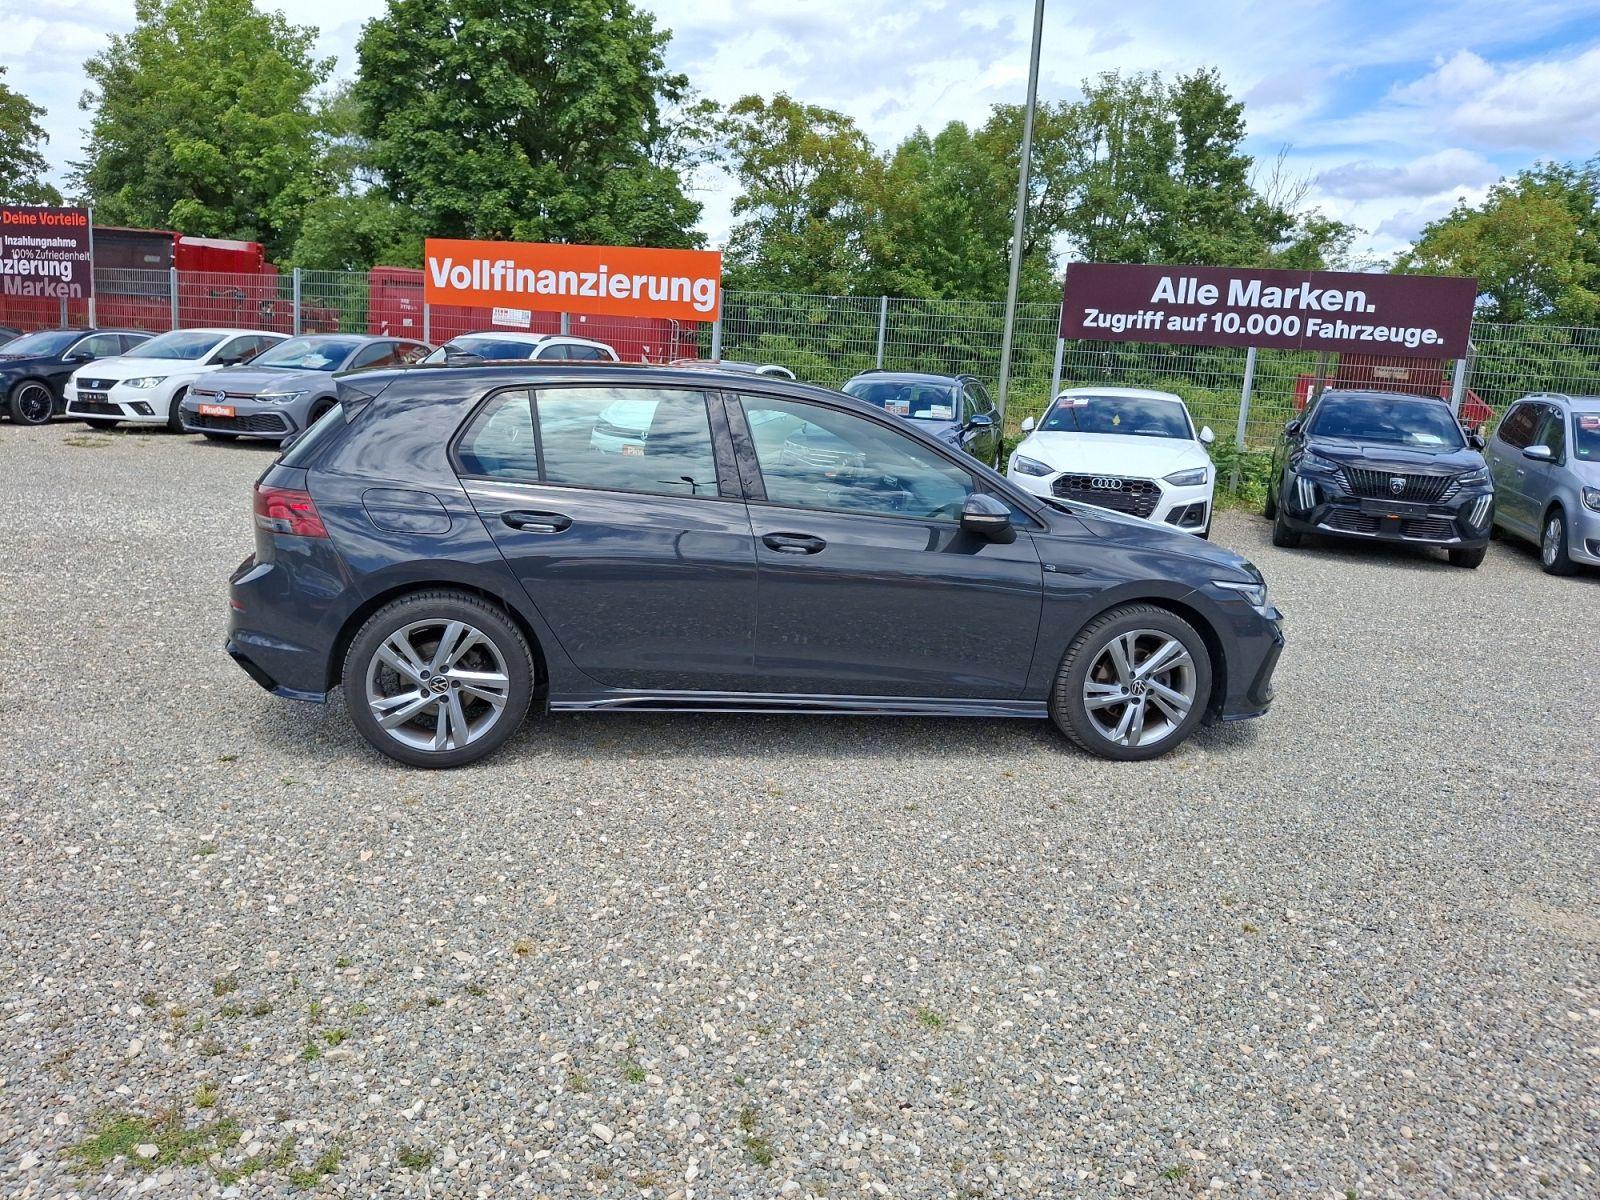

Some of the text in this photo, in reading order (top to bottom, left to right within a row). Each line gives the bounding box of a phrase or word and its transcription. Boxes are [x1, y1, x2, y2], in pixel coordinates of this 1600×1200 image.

[3, 211, 87, 226] Deine Vorteile
[4, 235, 77, 249] Inzahlungnahme
[11, 249, 91, 262] 100% Zufriedenheit
[3, 275, 82, 299] Marken
[428, 256, 717, 313] Vollfinanzierung
[1150, 276, 1376, 313] Alle Marken.
[1083, 308, 1444, 348] Zugriff auf 10.000 Fahrzeuge.
